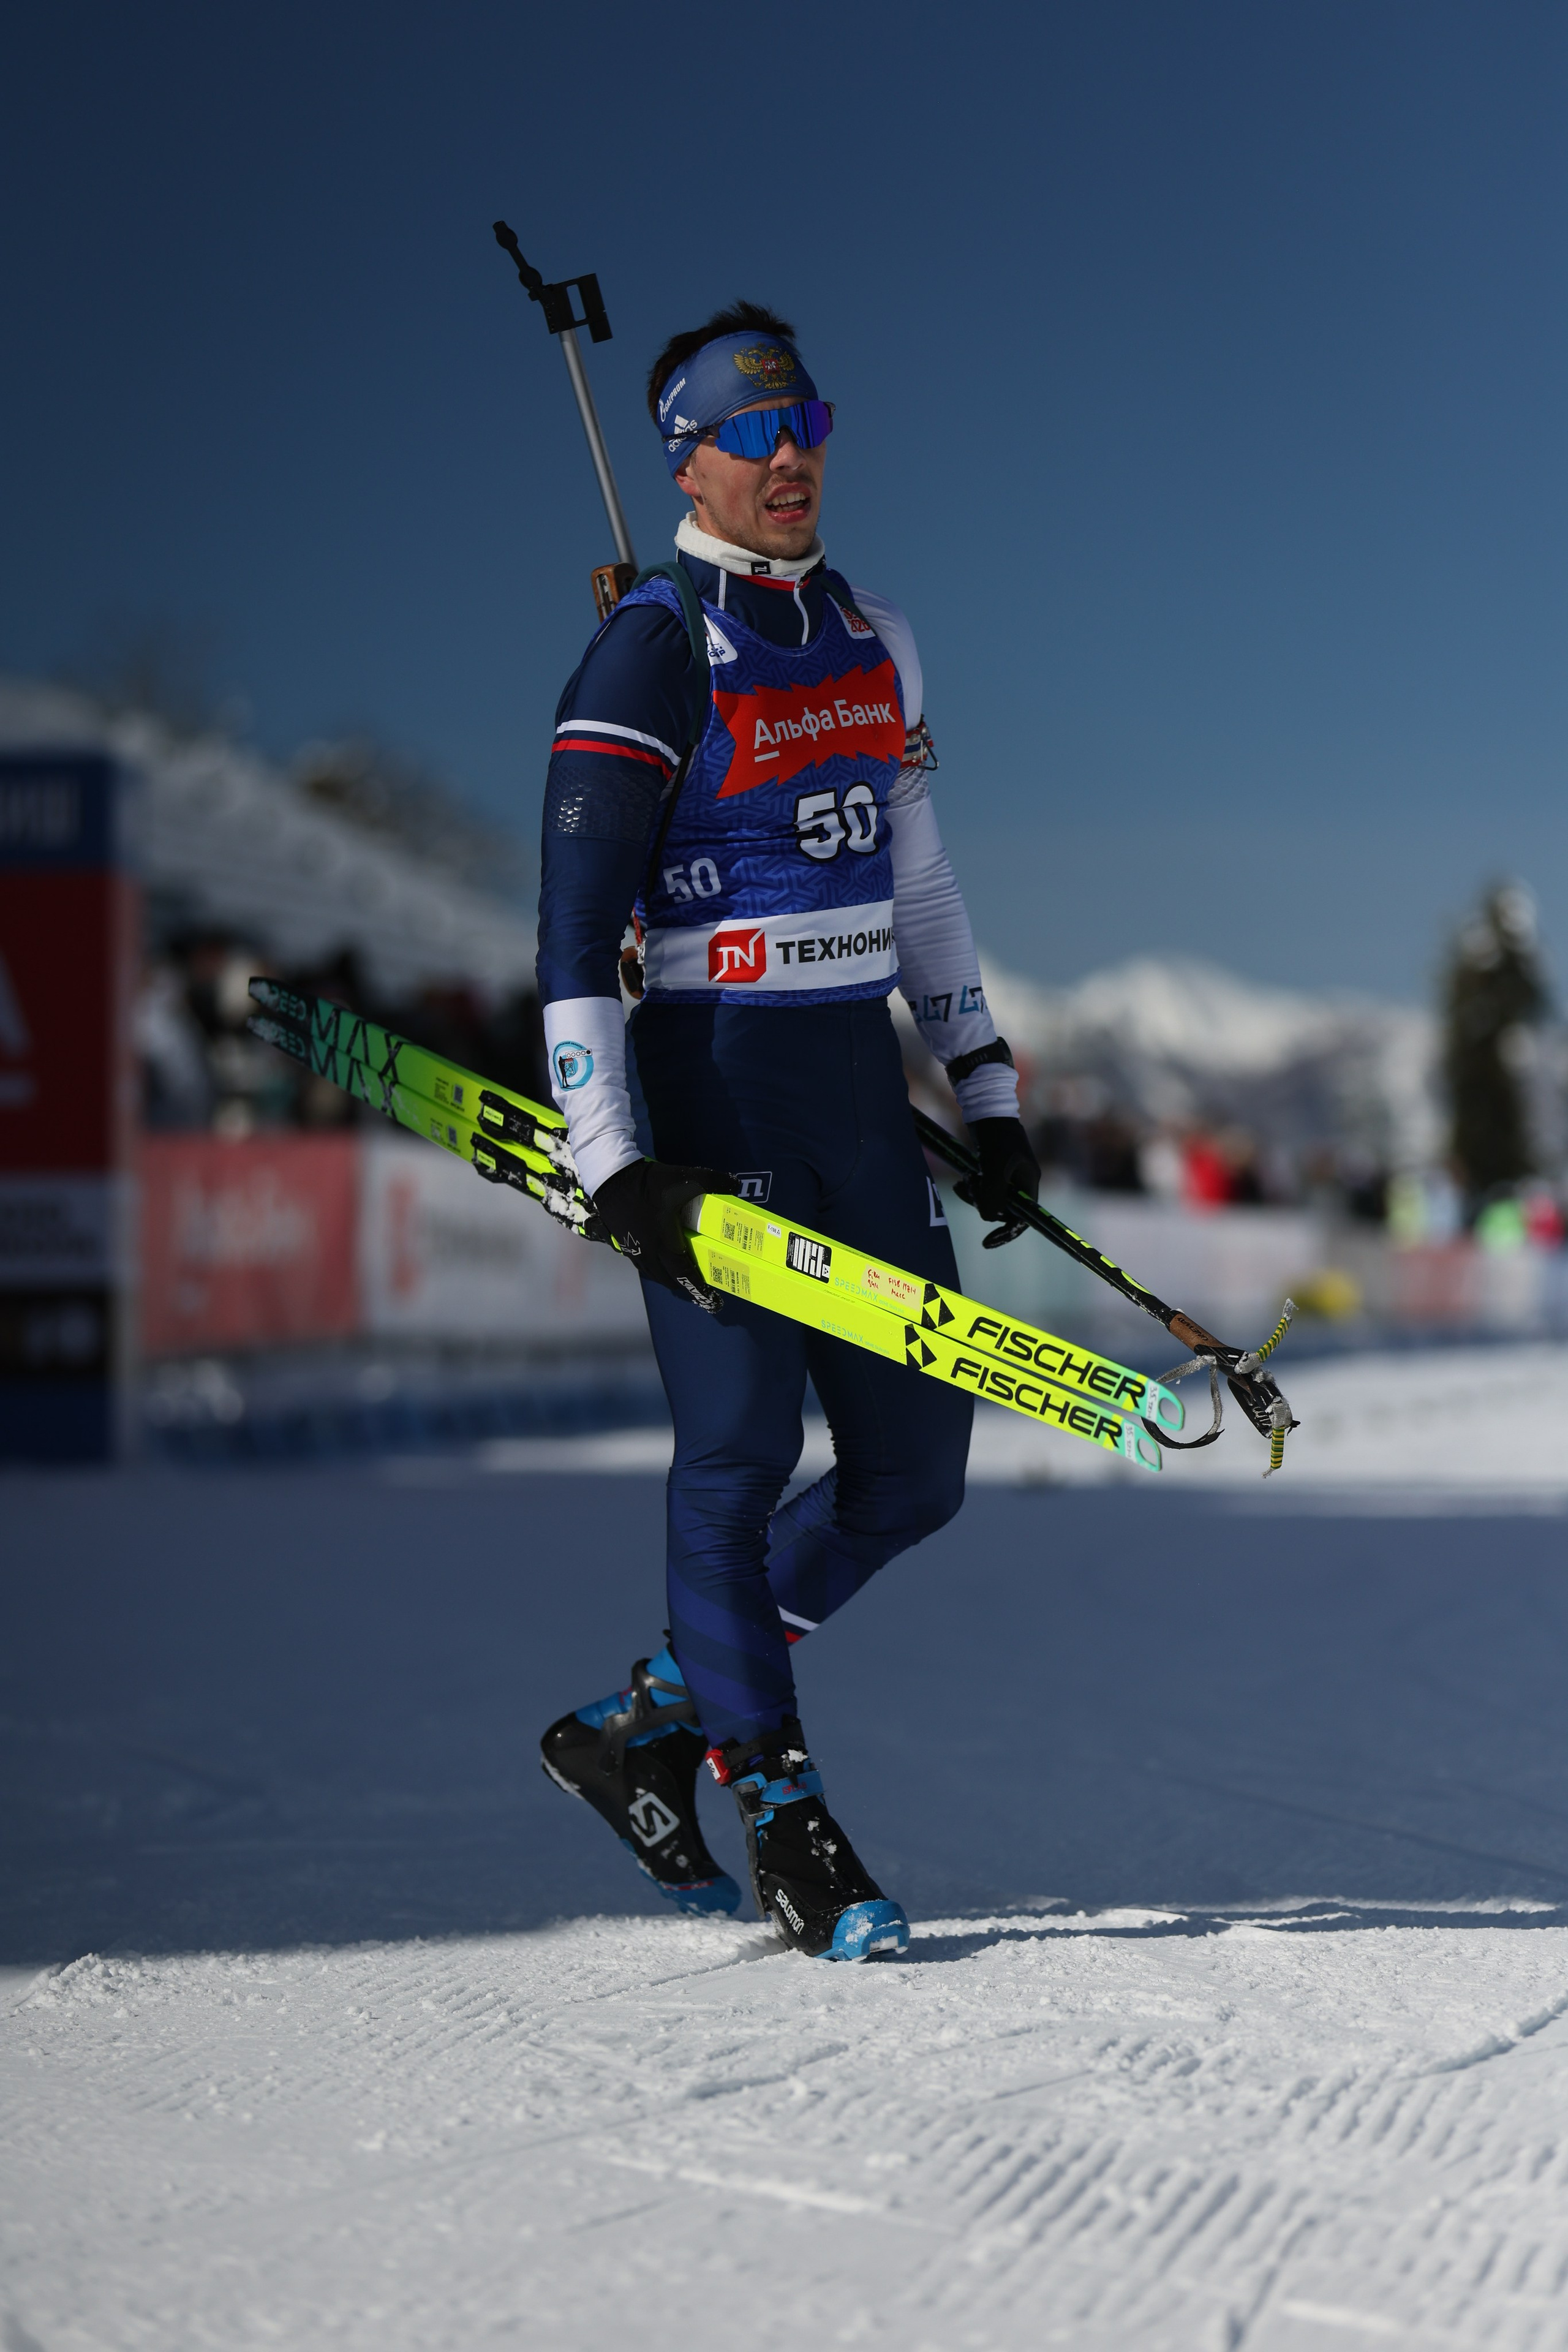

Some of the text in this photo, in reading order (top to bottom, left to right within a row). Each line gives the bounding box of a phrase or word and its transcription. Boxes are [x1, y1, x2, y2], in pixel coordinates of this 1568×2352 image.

[665, 378, 685, 412] GAZPROM
[754, 699, 896, 749] Альфа Банк
[794, 781, 880, 863] 50
[663, 858, 722, 903] 50
[835, 1277, 878, 1302] SPEEDMAX
[821, 1319, 864, 1343] SPEEDMAX
[1178, 1317, 1208, 1341] ONEWAY
[967, 1316, 1145, 1409] FISCHER
[951, 1357, 1123, 1449] FISCHER
[775, 1889, 805, 1936] salomon
